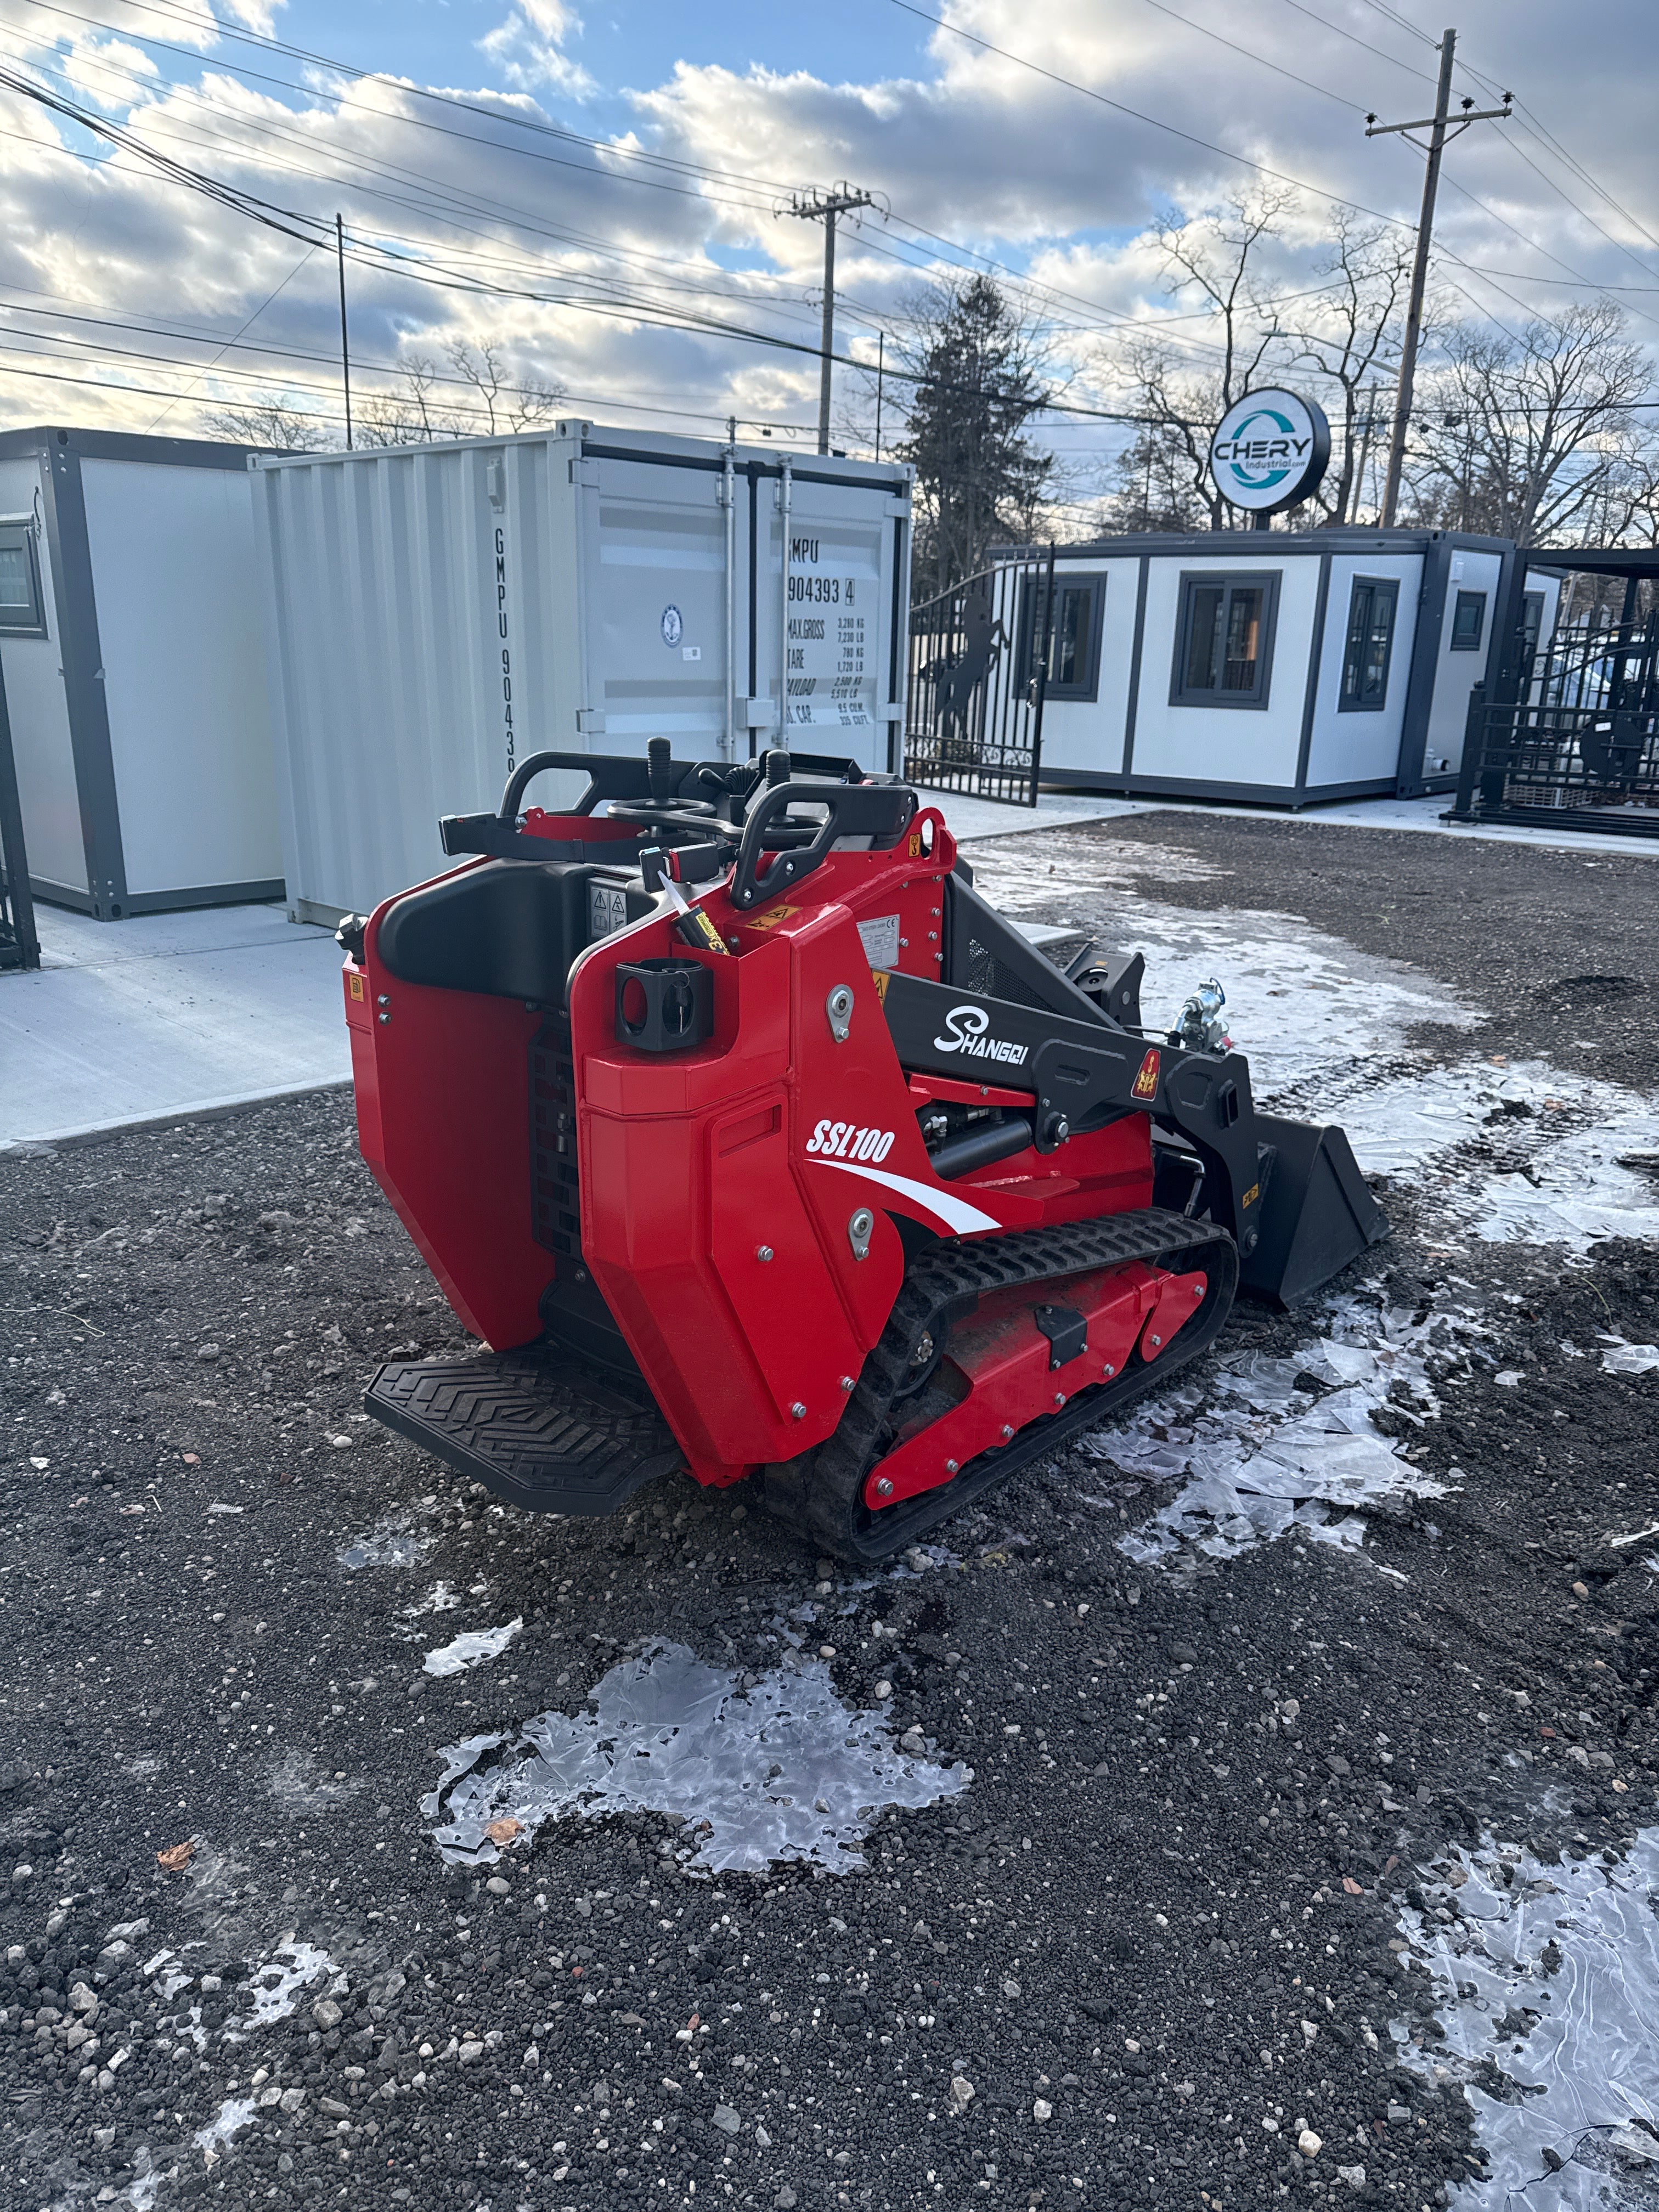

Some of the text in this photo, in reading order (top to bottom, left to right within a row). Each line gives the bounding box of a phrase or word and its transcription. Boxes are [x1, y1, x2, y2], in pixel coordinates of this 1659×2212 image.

[1215, 438, 1311, 460] CHERY
[495, 528, 507, 639] GMPU
[788, 577, 839, 603] 904393
[856, 618, 865, 629] KG
[856, 632, 864, 642] LB
[856, 647, 864, 658] KG
[855, 661, 864, 672] LB
[787, 678, 817, 696] AYLOAD
[850, 688, 859, 698] LB
[796, 705, 816, 724] CAP.
[934, 1005, 1029, 1065] SHANGQI
[806, 1119, 895, 1163] SSL100
